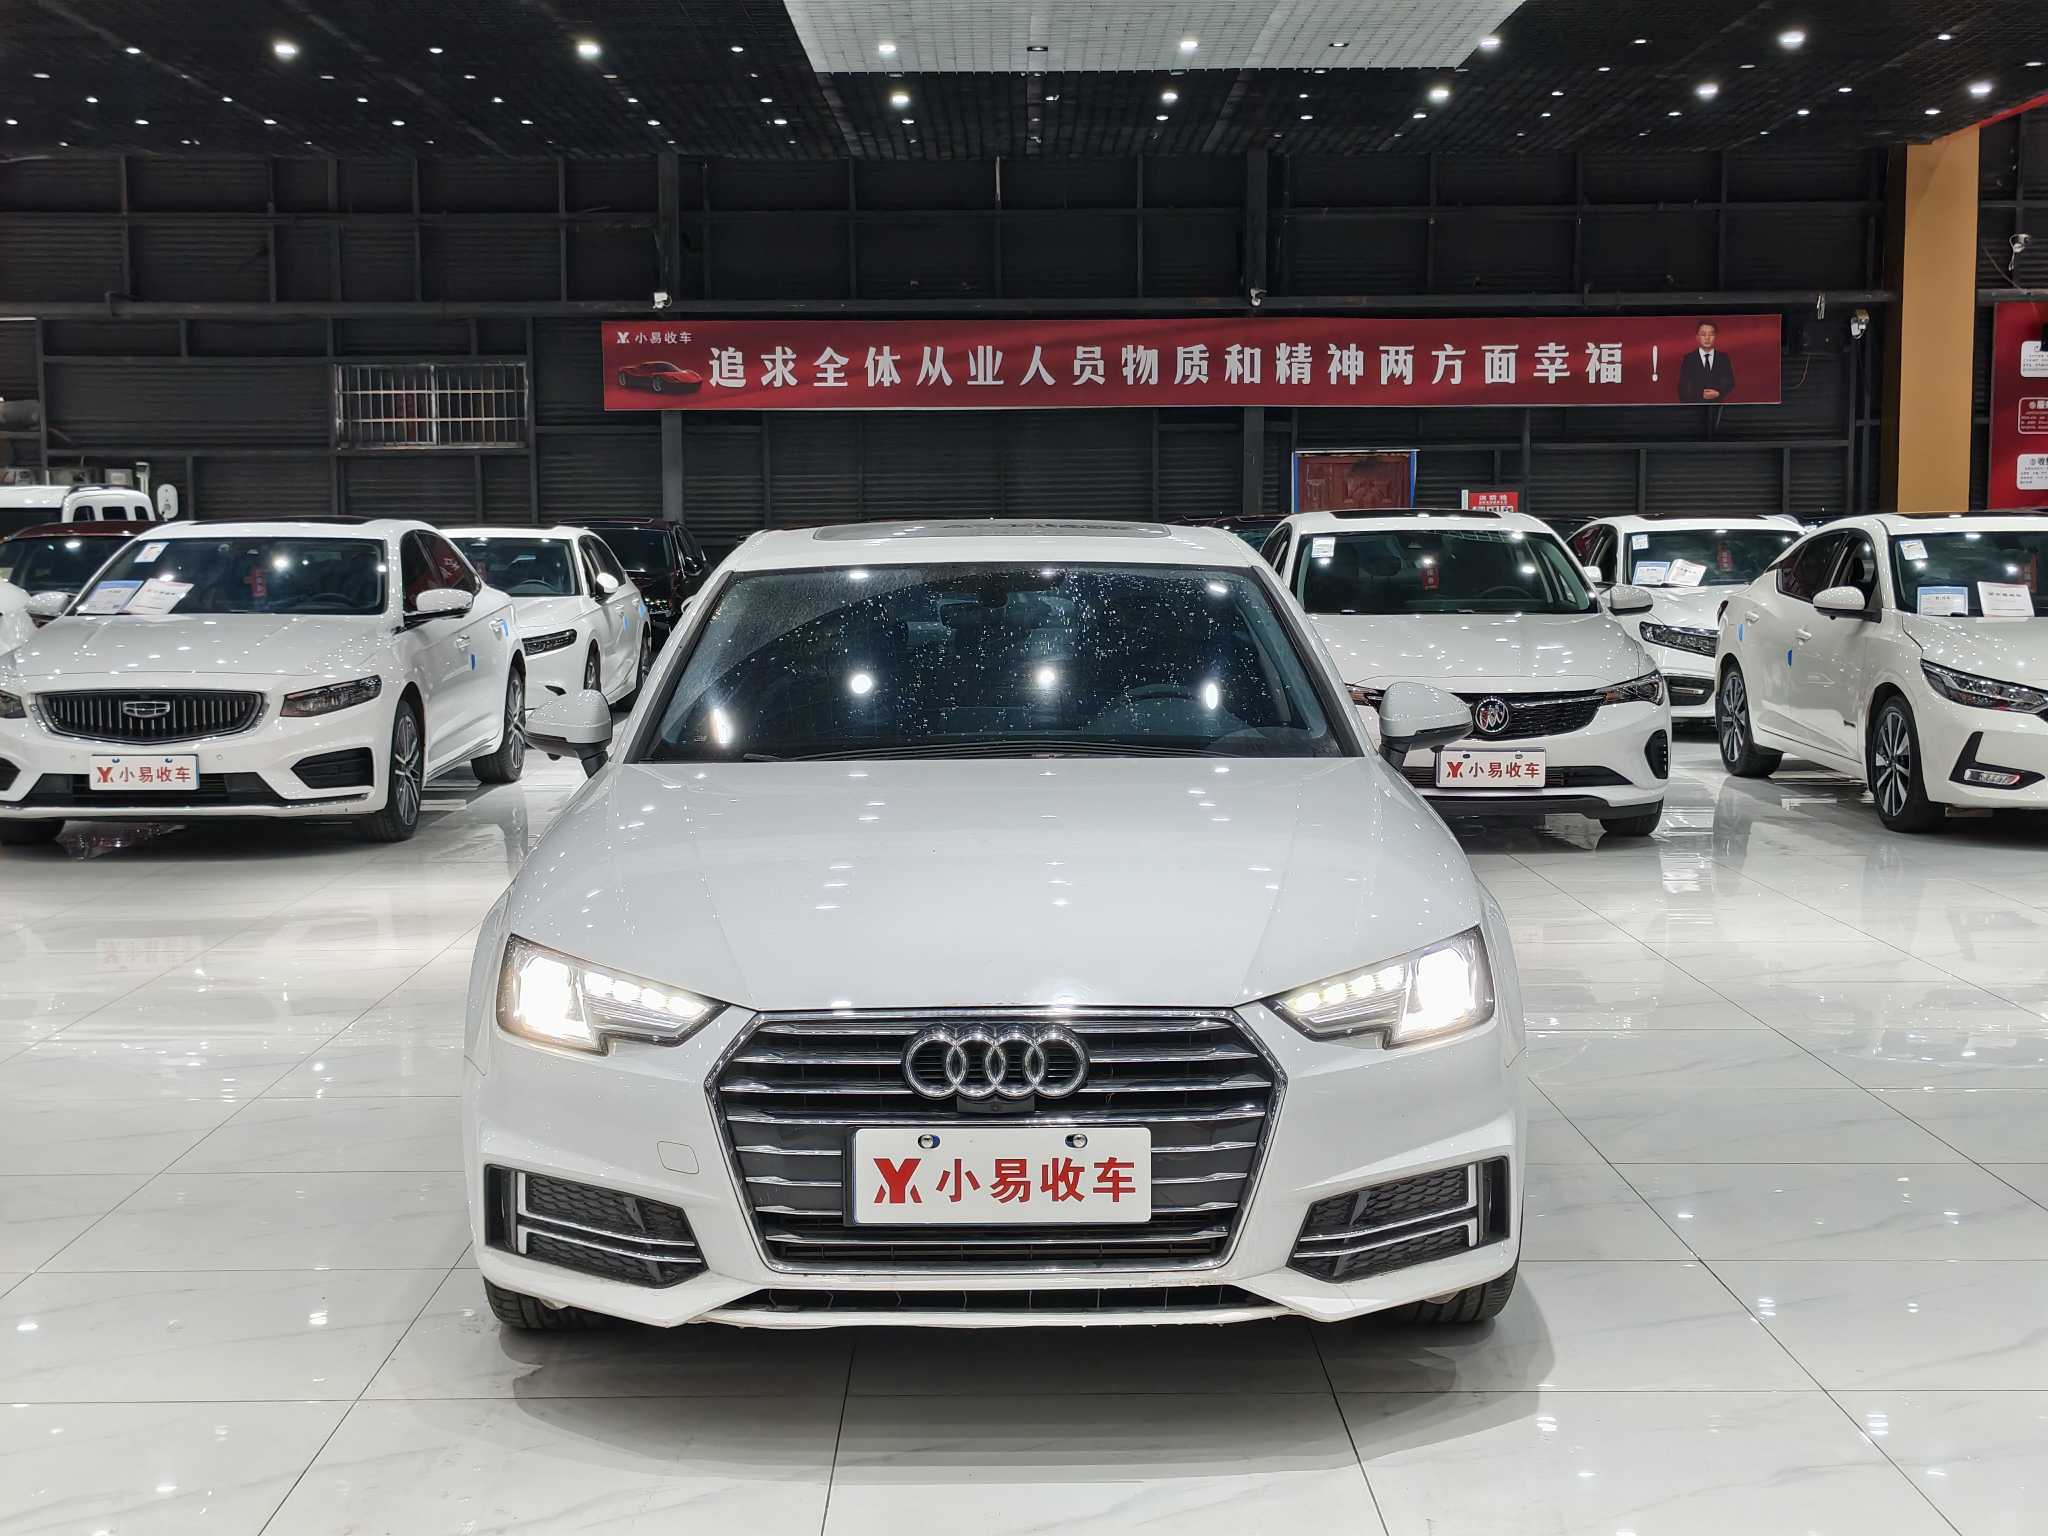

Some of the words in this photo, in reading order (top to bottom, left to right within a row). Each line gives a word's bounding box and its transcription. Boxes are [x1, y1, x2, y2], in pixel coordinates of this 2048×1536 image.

[635, 331, 692, 344] 小易收车
[120, 766, 191, 783] 小易收车
[1468, 761, 1540, 779] 小易收车
[935, 1156, 1136, 1203] 小易收车
